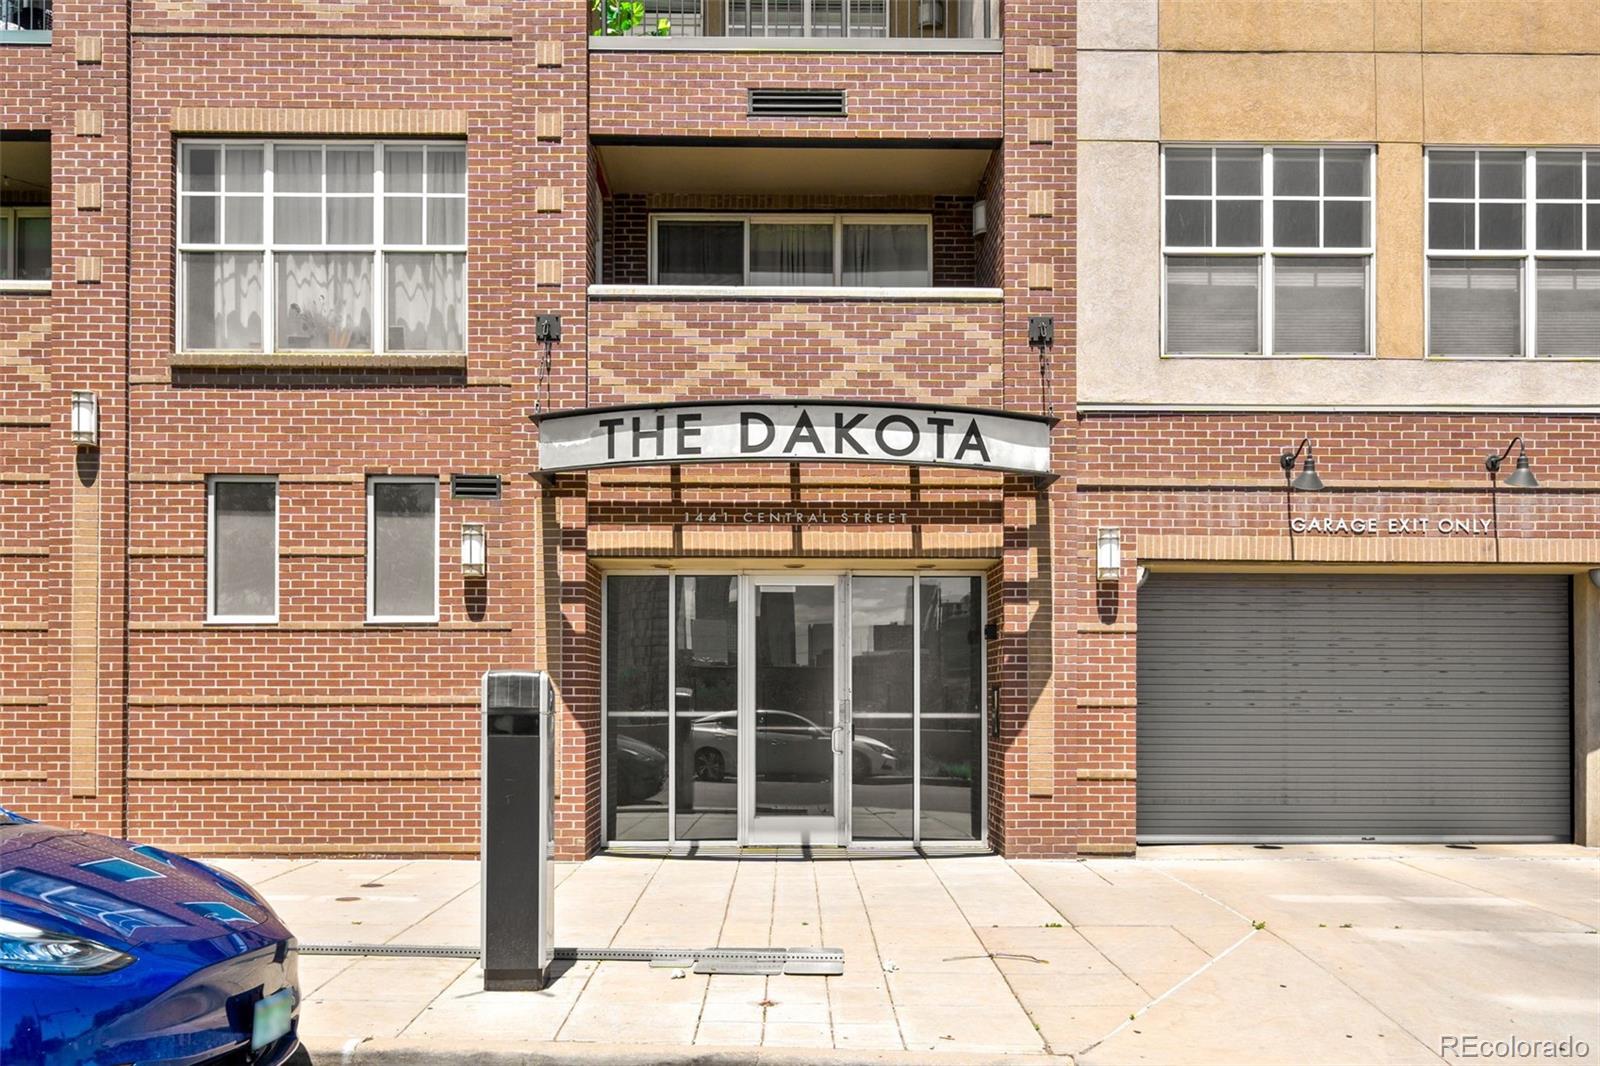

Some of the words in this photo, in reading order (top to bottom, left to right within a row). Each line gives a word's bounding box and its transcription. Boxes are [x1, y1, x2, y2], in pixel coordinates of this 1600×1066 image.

[600, 413, 702, 459] THE
[739, 408, 991, 463] DAKOTA
[685, 512, 728, 523] 1441
[743, 512, 828, 523] CENTRAL
[841, 512, 908, 523] STREET
[1291, 517, 1377, 533] GARAGE
[1388, 517, 1428, 533] EXIT
[1437, 517, 1492, 533] ONLY
